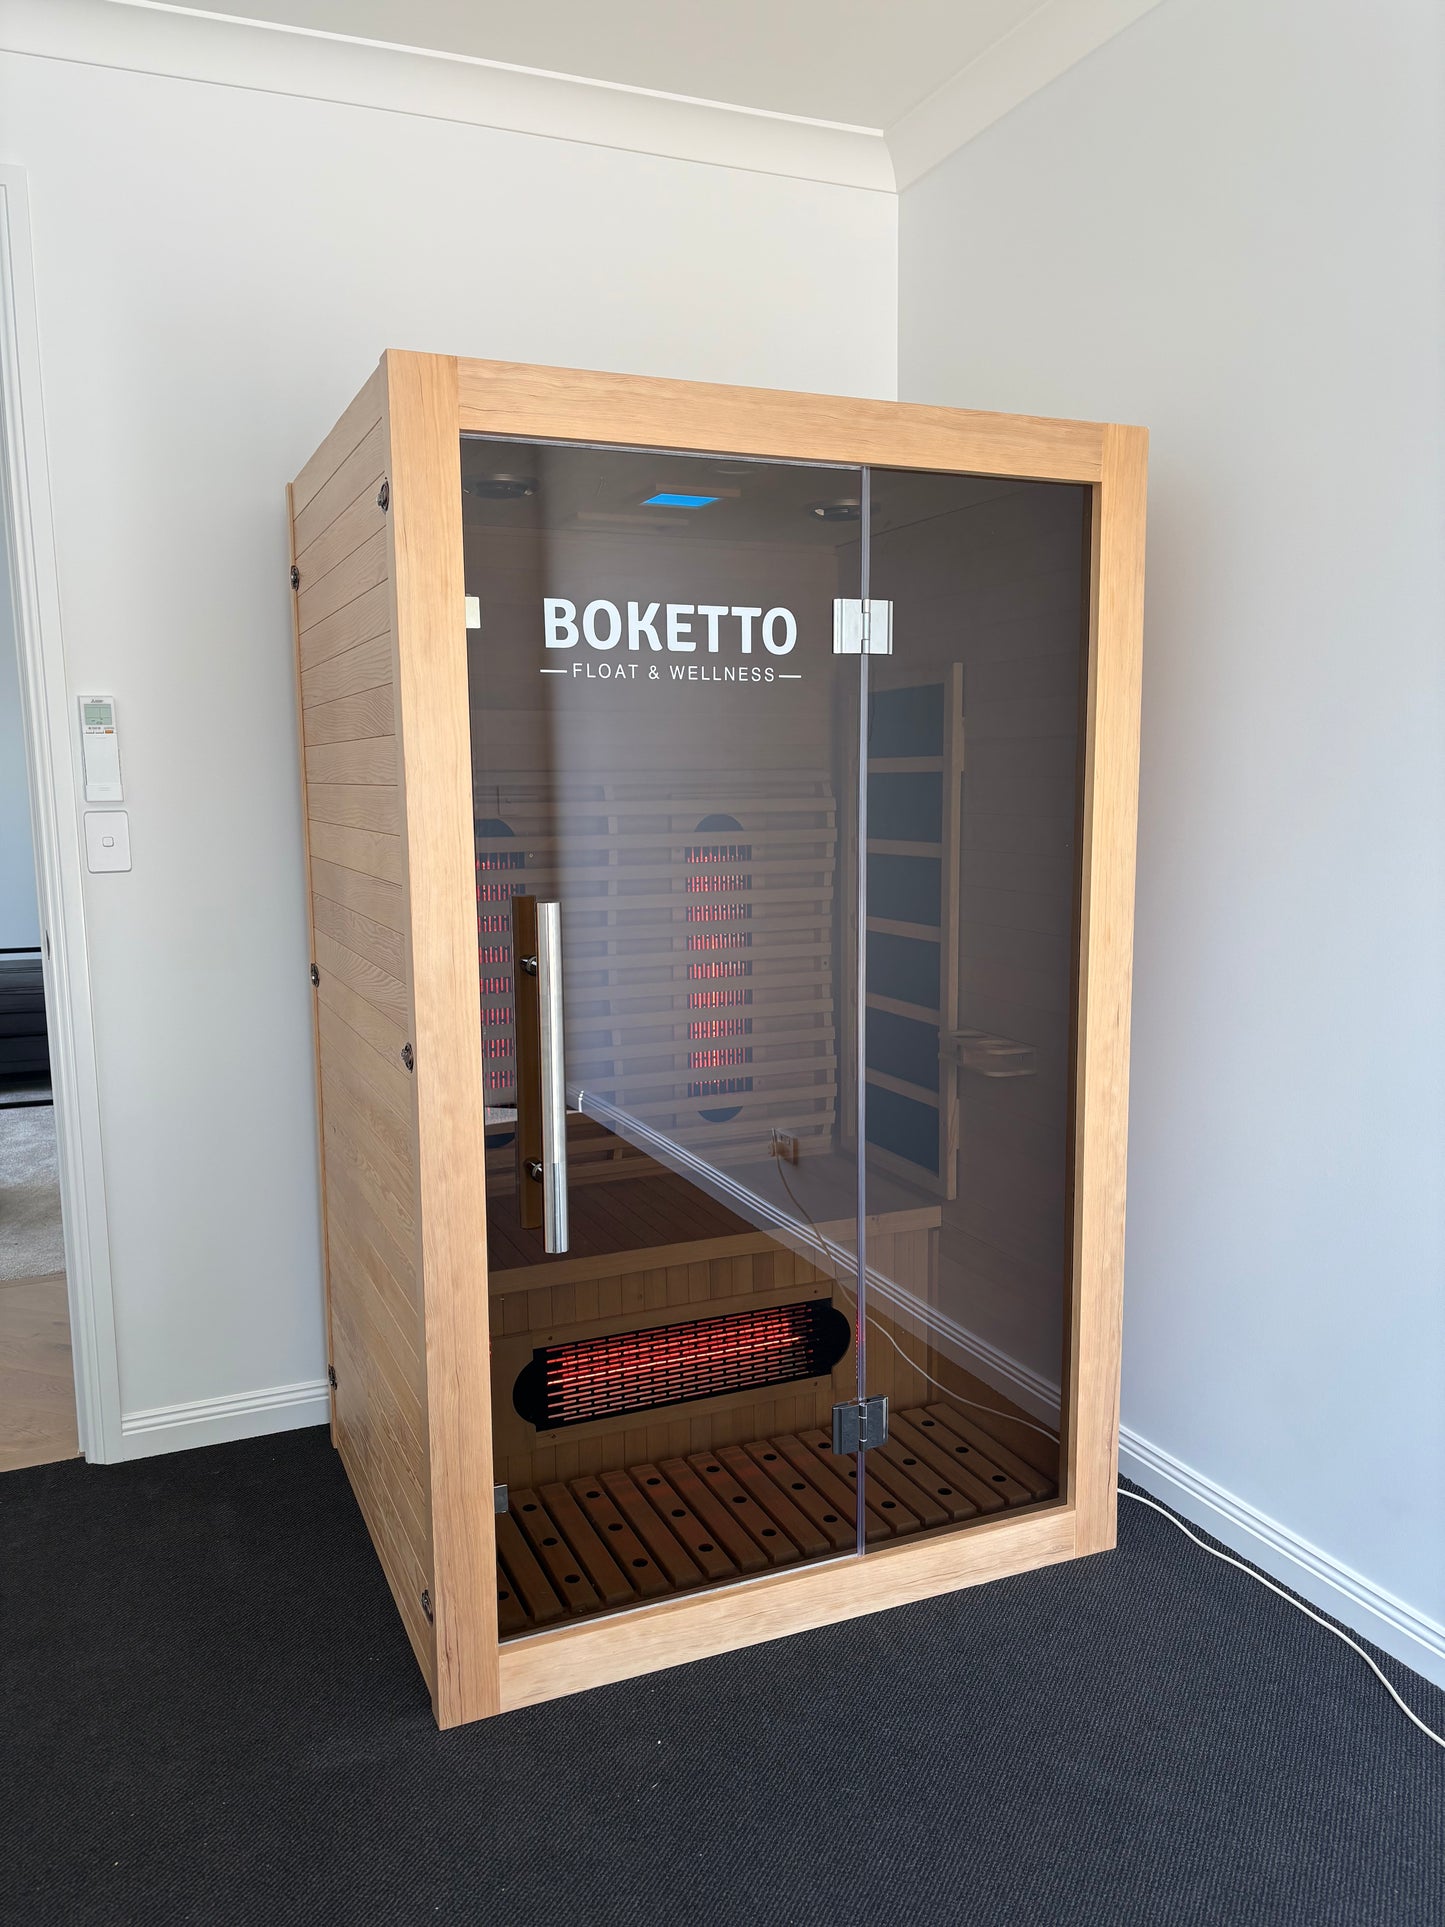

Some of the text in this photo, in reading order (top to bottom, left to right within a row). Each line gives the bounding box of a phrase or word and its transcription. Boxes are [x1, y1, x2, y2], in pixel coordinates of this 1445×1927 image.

[543, 597, 798, 656] BOKETTO
[572, 662, 775, 683] FLOAT & WELLNESS
